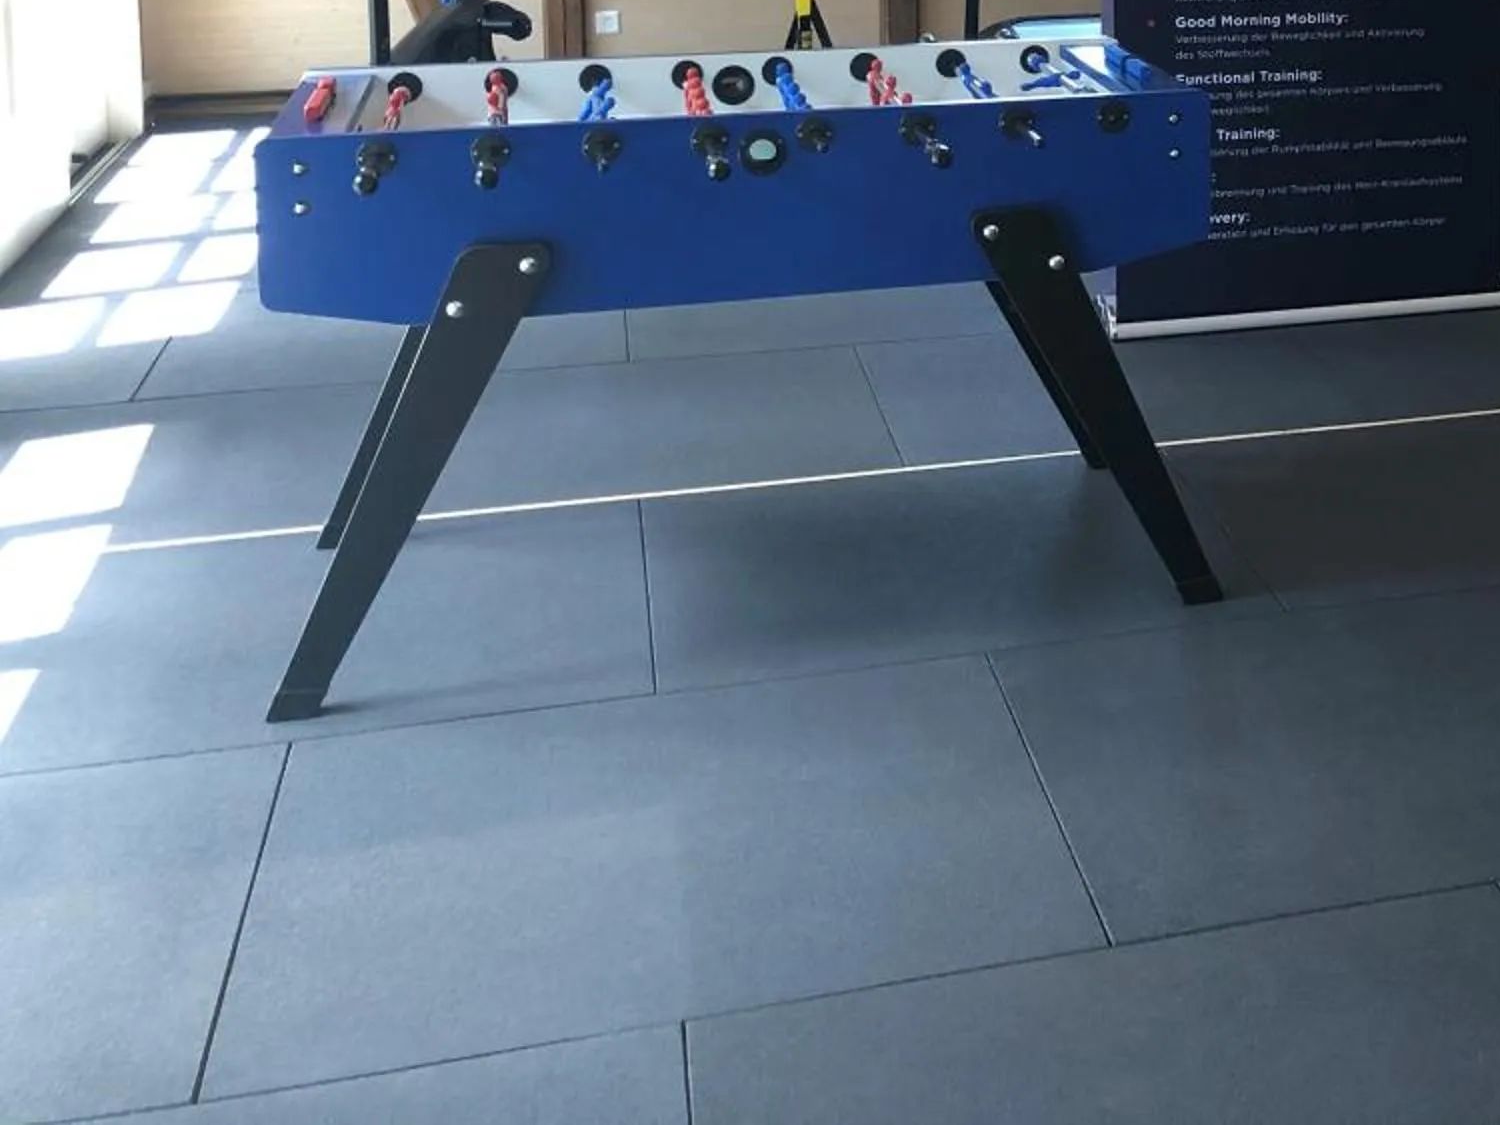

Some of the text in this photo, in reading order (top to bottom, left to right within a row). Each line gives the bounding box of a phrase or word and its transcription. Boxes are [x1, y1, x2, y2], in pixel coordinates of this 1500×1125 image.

[1175, 11, 1349, 28] Good Morning Mobility:
[1175, 68, 1323, 86] Functional Training:
[1216, 126, 1281, 143] Training:
